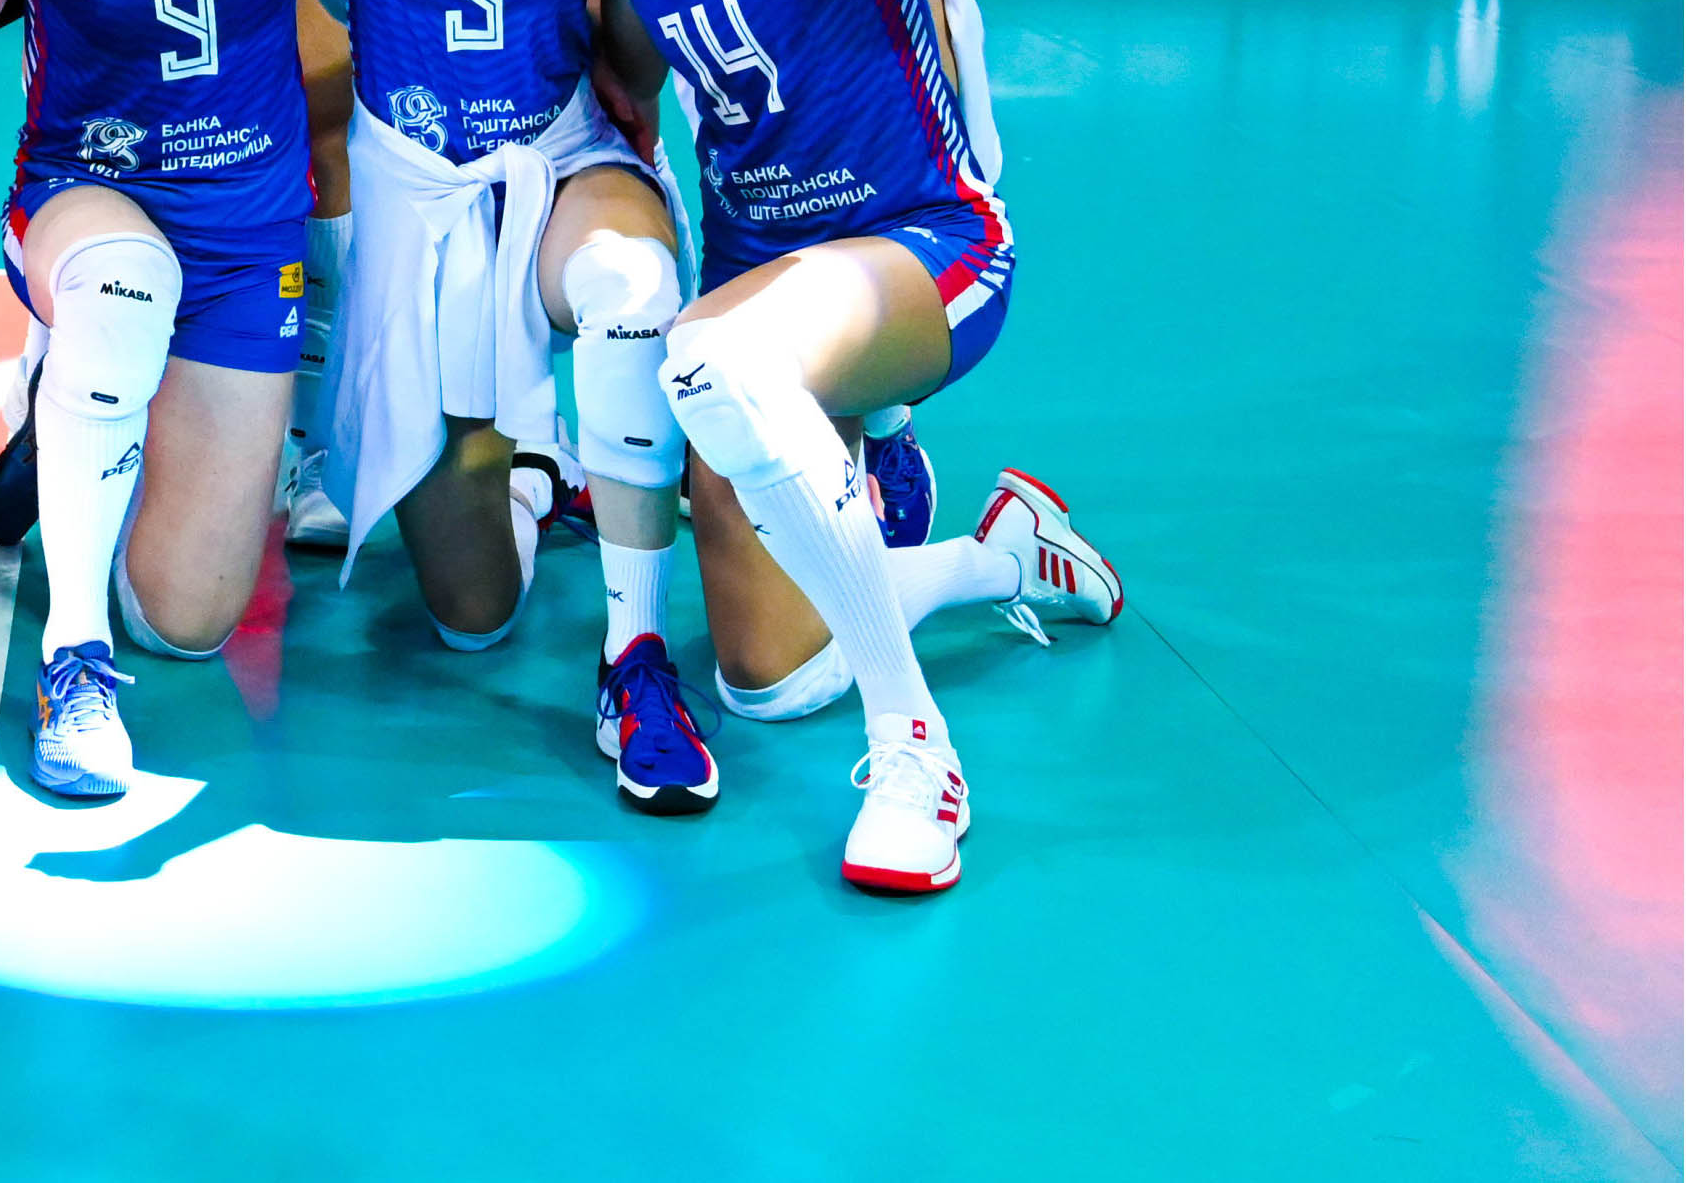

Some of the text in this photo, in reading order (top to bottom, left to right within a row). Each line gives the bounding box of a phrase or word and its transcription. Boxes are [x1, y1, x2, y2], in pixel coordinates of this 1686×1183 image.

[161, 115, 222, 138] БАНКА
[161, 133, 273, 172] ШТЕДИОНИЦА
[89, 162, 120, 179] 1921
[730, 163, 792, 185] БАНКА
[740, 167, 856, 200] ПОШТАНСКА
[748, 182, 878, 221] ШТЕДИОНИЦА
[100, 455, 141, 481] PEA
